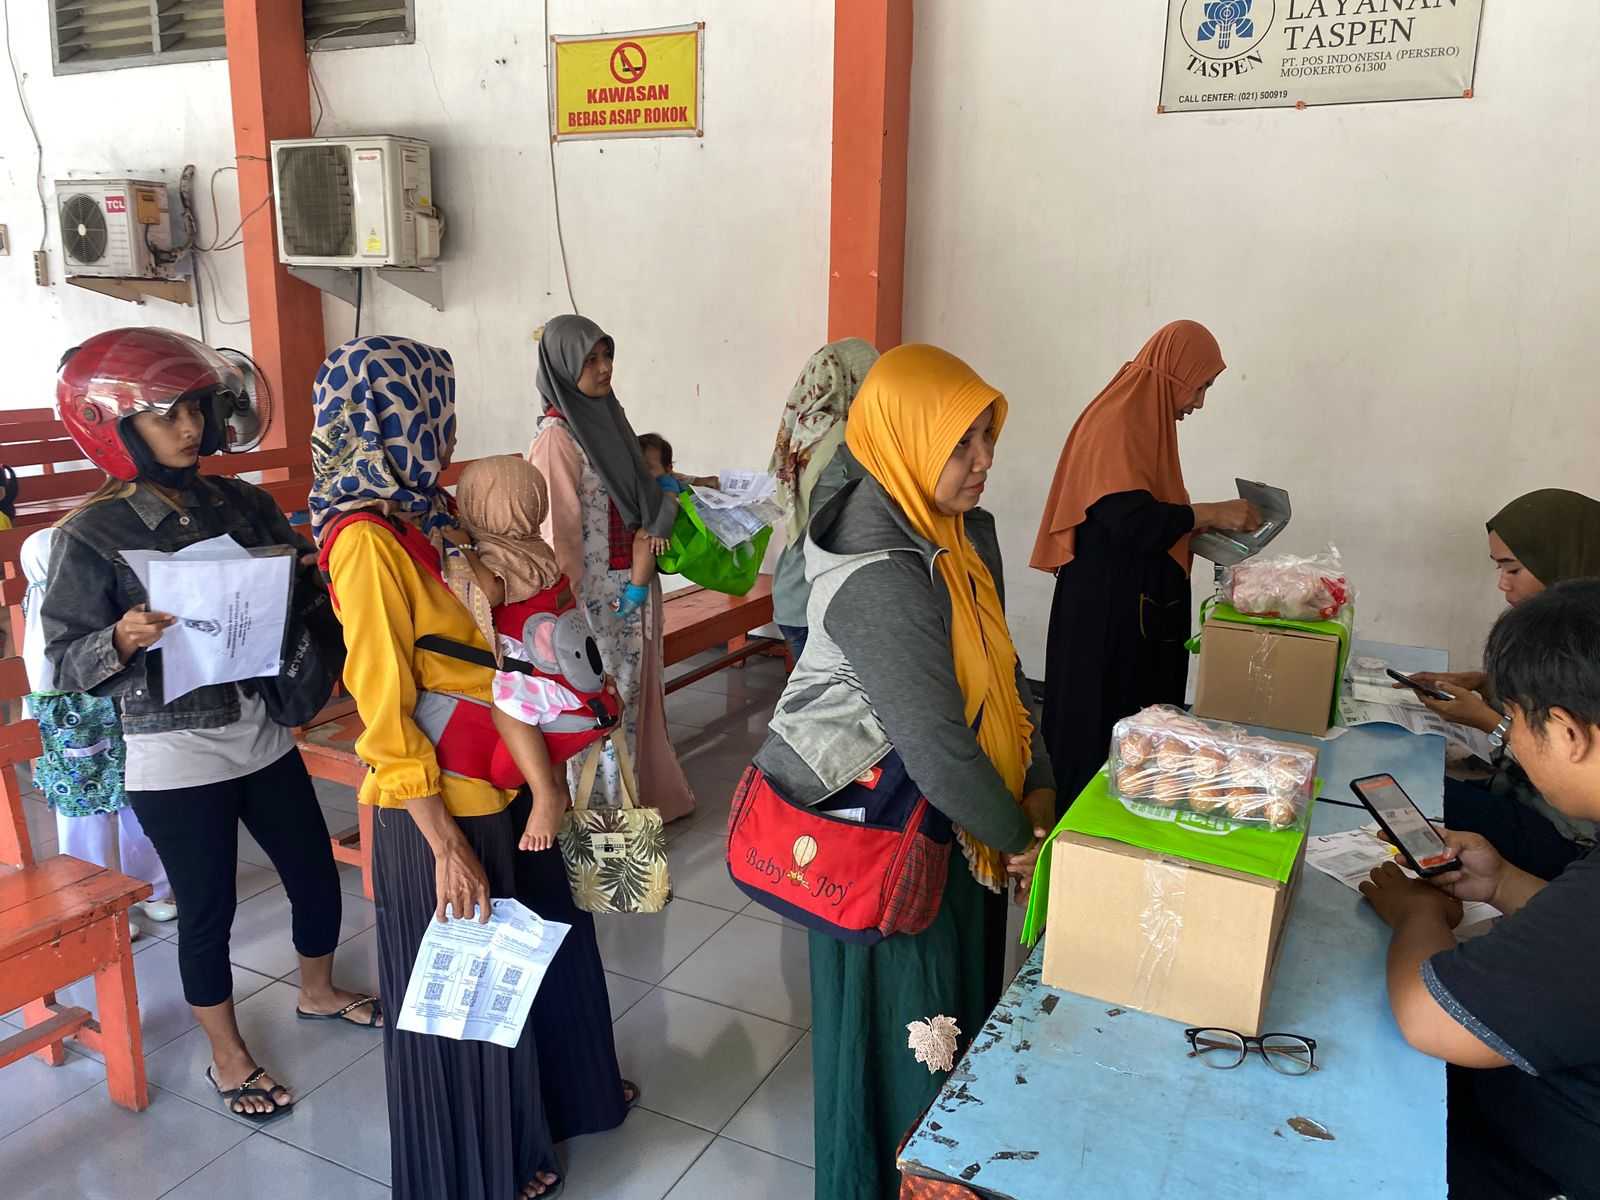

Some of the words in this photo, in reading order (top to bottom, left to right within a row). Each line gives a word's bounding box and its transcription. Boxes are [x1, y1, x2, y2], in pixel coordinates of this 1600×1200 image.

[1283, 17, 1415, 51] TASPEN
[1187, 51, 1263, 78] TASPEN
[1281, 57, 1298, 67] PT.
[1301, 55, 1324, 66] POS
[1326, 51, 1392, 64] INDONESIA
[1396, 46, 1460, 61] (PERSERO)
[1280, 63, 1352, 78] MOJOKERTO
[1354, 62, 1386, 73] 61300
[587, 84, 669, 104] KAWASAN
[1178, 95, 1199, 103] CALL
[1201, 92, 1236, 102] CENTER:
[1238, 91, 1258, 102] (021)
[1260, 90, 1288, 100] 500919
[568, 110, 607, 127] BEBAS
[609, 108, 641, 126] ASAP
[644, 106, 688, 124] ROKOK
[106, 201, 125, 209] TCL
[745, 847, 786, 884] Baby
[811, 875, 849, 906] Joy
